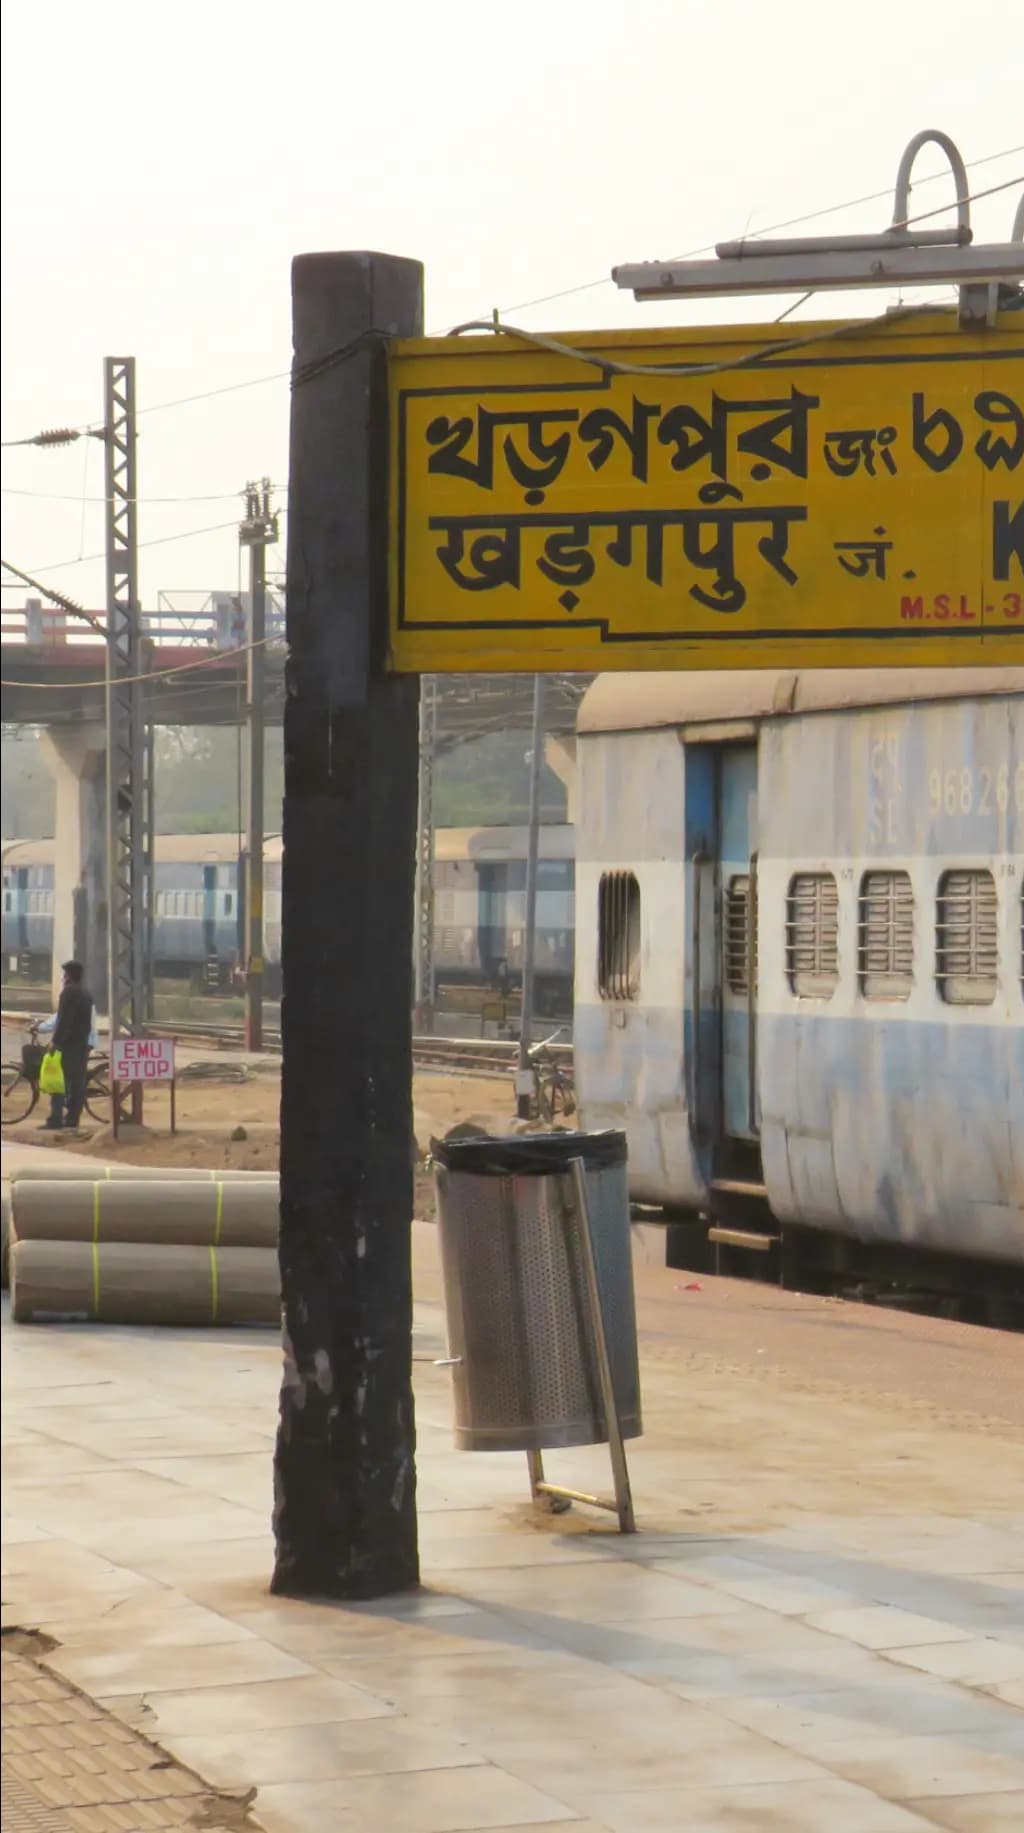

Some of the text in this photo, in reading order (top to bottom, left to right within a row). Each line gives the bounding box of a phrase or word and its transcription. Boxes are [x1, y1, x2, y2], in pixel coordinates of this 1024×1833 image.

[426, 384, 820, 506] খড়গপুর
[428, 505, 808, 614] खड़गपुर
[117, 1060, 170, 1077] STOP
[123, 1042, 163, 1059] EMU
